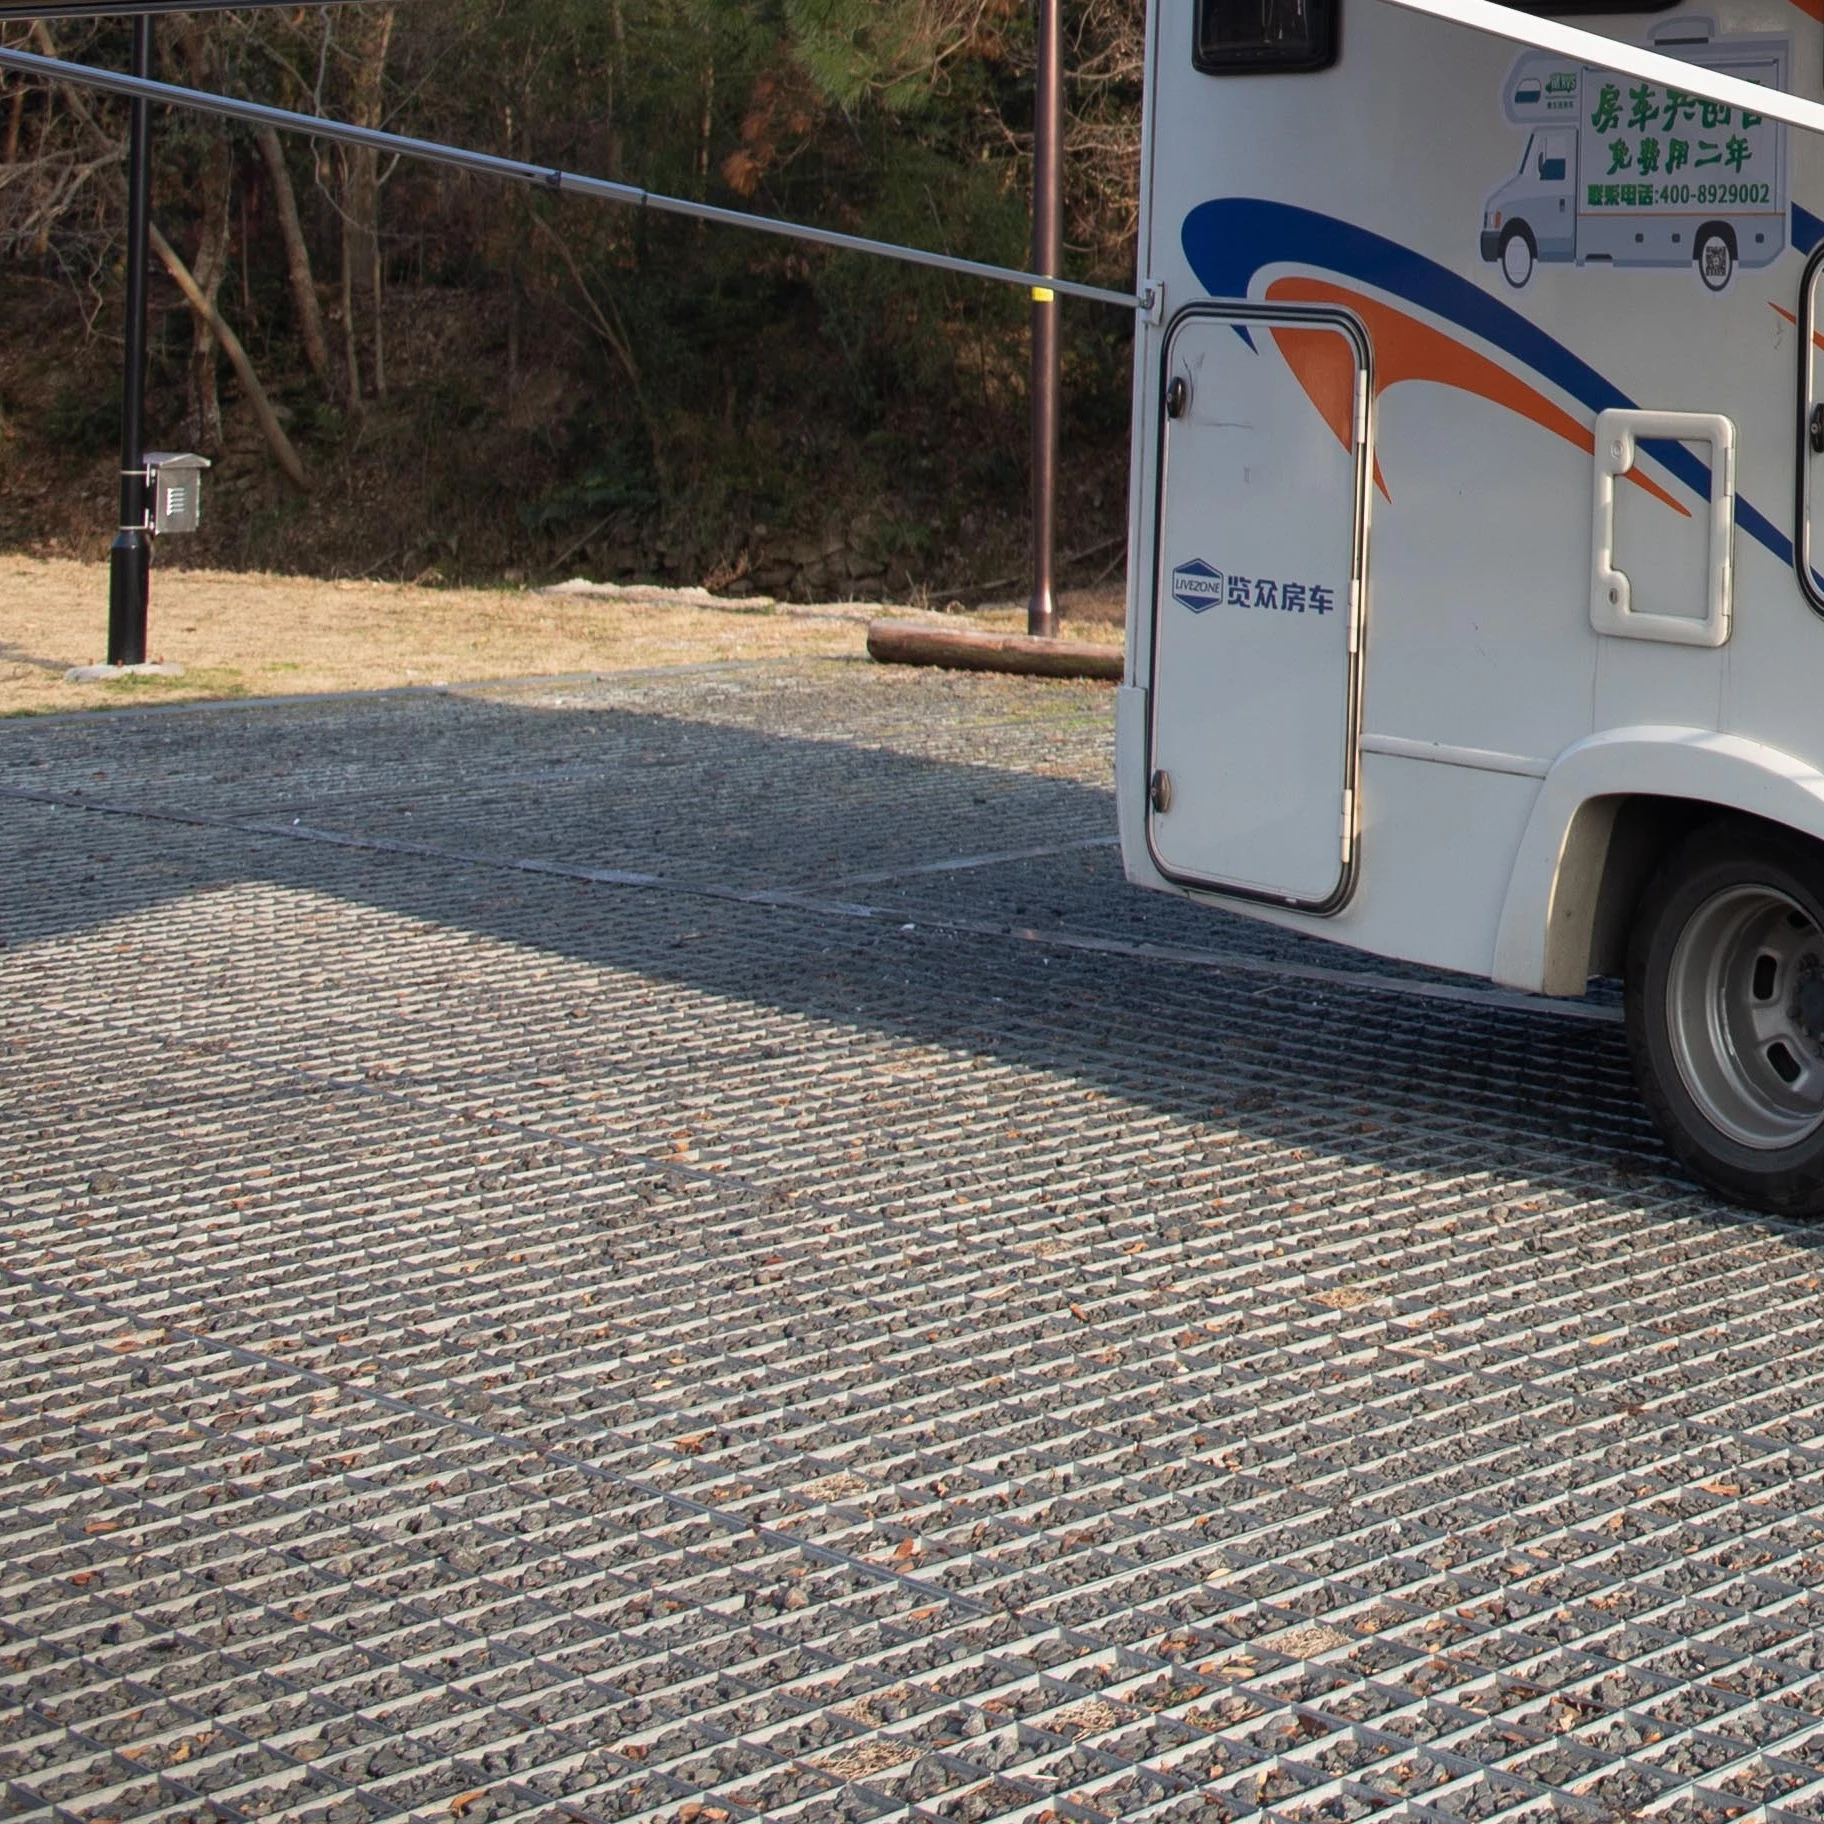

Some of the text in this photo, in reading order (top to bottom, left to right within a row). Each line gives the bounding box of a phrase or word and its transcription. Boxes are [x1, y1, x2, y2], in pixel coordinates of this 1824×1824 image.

[1175, 578, 1221, 594] LIVEZONE
[1227, 575, 1334, 615] 览众房车
